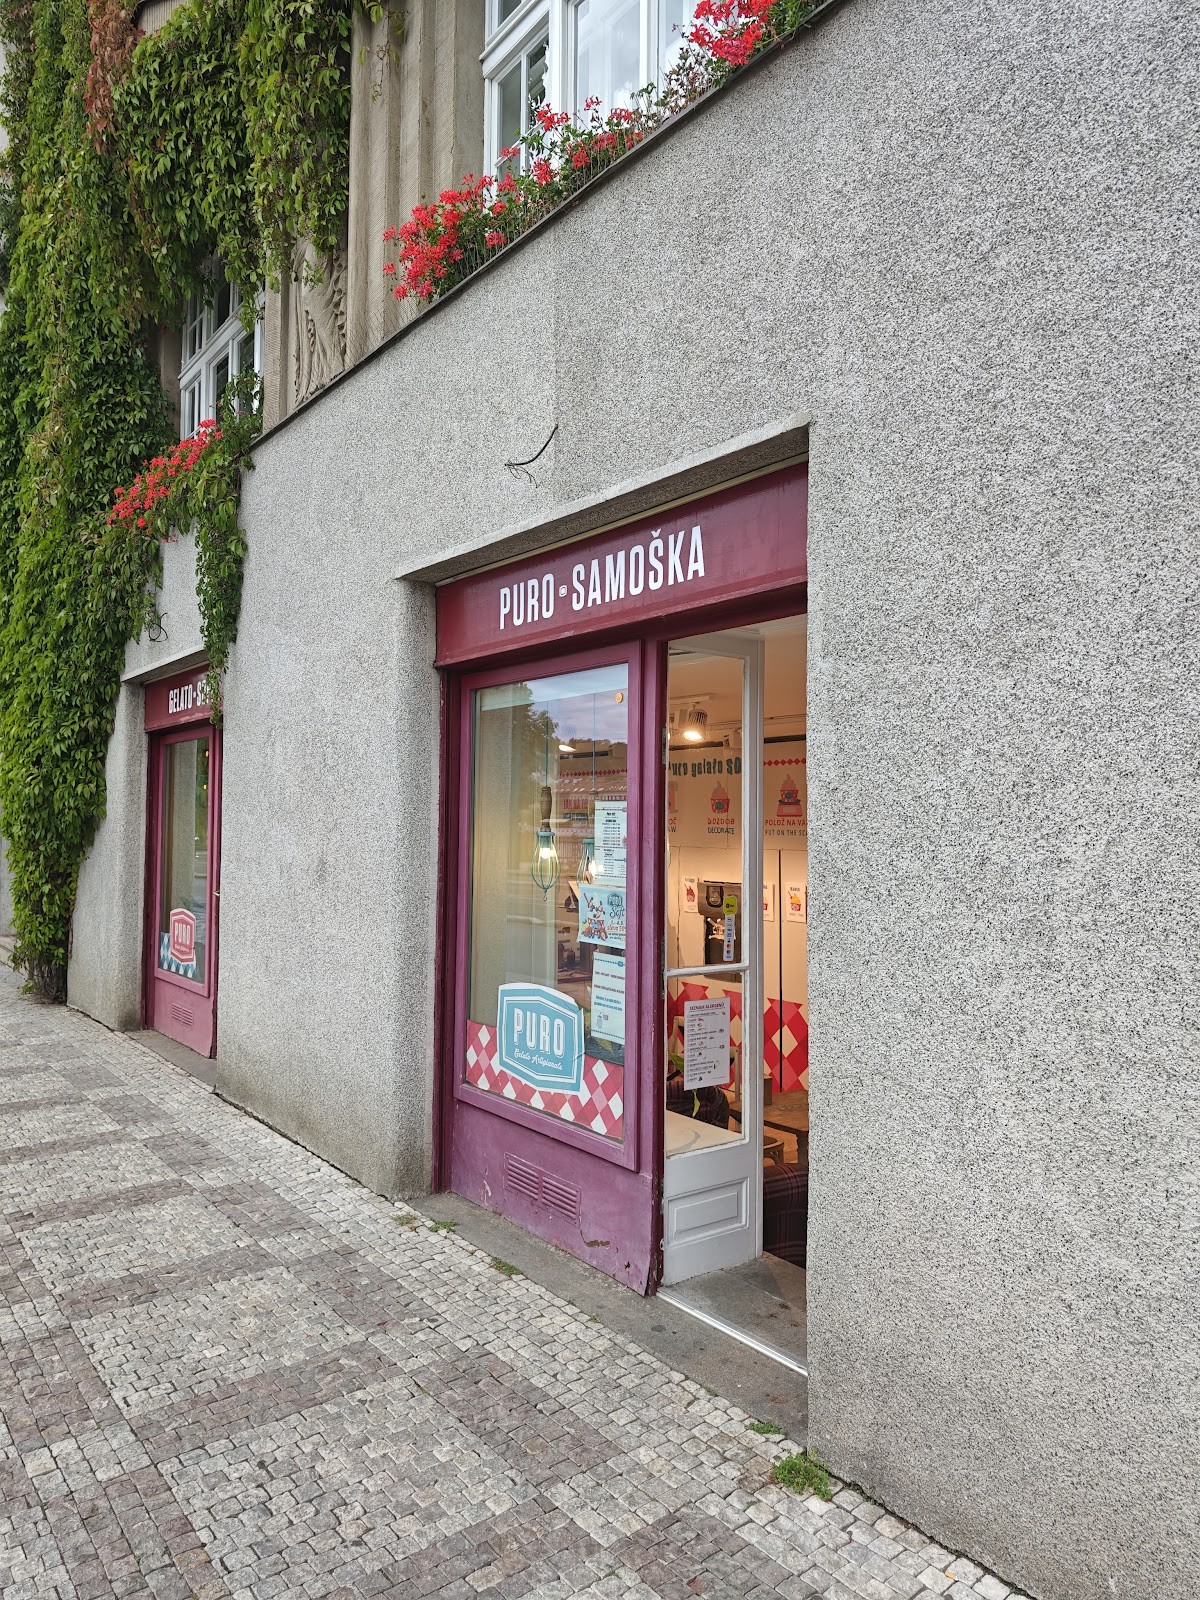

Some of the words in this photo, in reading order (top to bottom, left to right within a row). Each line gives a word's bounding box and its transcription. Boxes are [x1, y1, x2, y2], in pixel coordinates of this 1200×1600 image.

[499, 573, 555, 630] PURO
[571, 525, 705, 611] SAMOŠKA
[168, 683, 193, 714] GELATO
[691, 758, 723, 777] gelato
[726, 756, 742, 775] SO
[707, 827, 735, 835] DECORATE
[765, 818, 785, 826] POLOŽ
[798, 818, 806, 826] VÁ
[175, 922, 191, 946] PURO
[513, 1007, 566, 1059] PURO
[514, 1048, 531, 1060] Gelato
